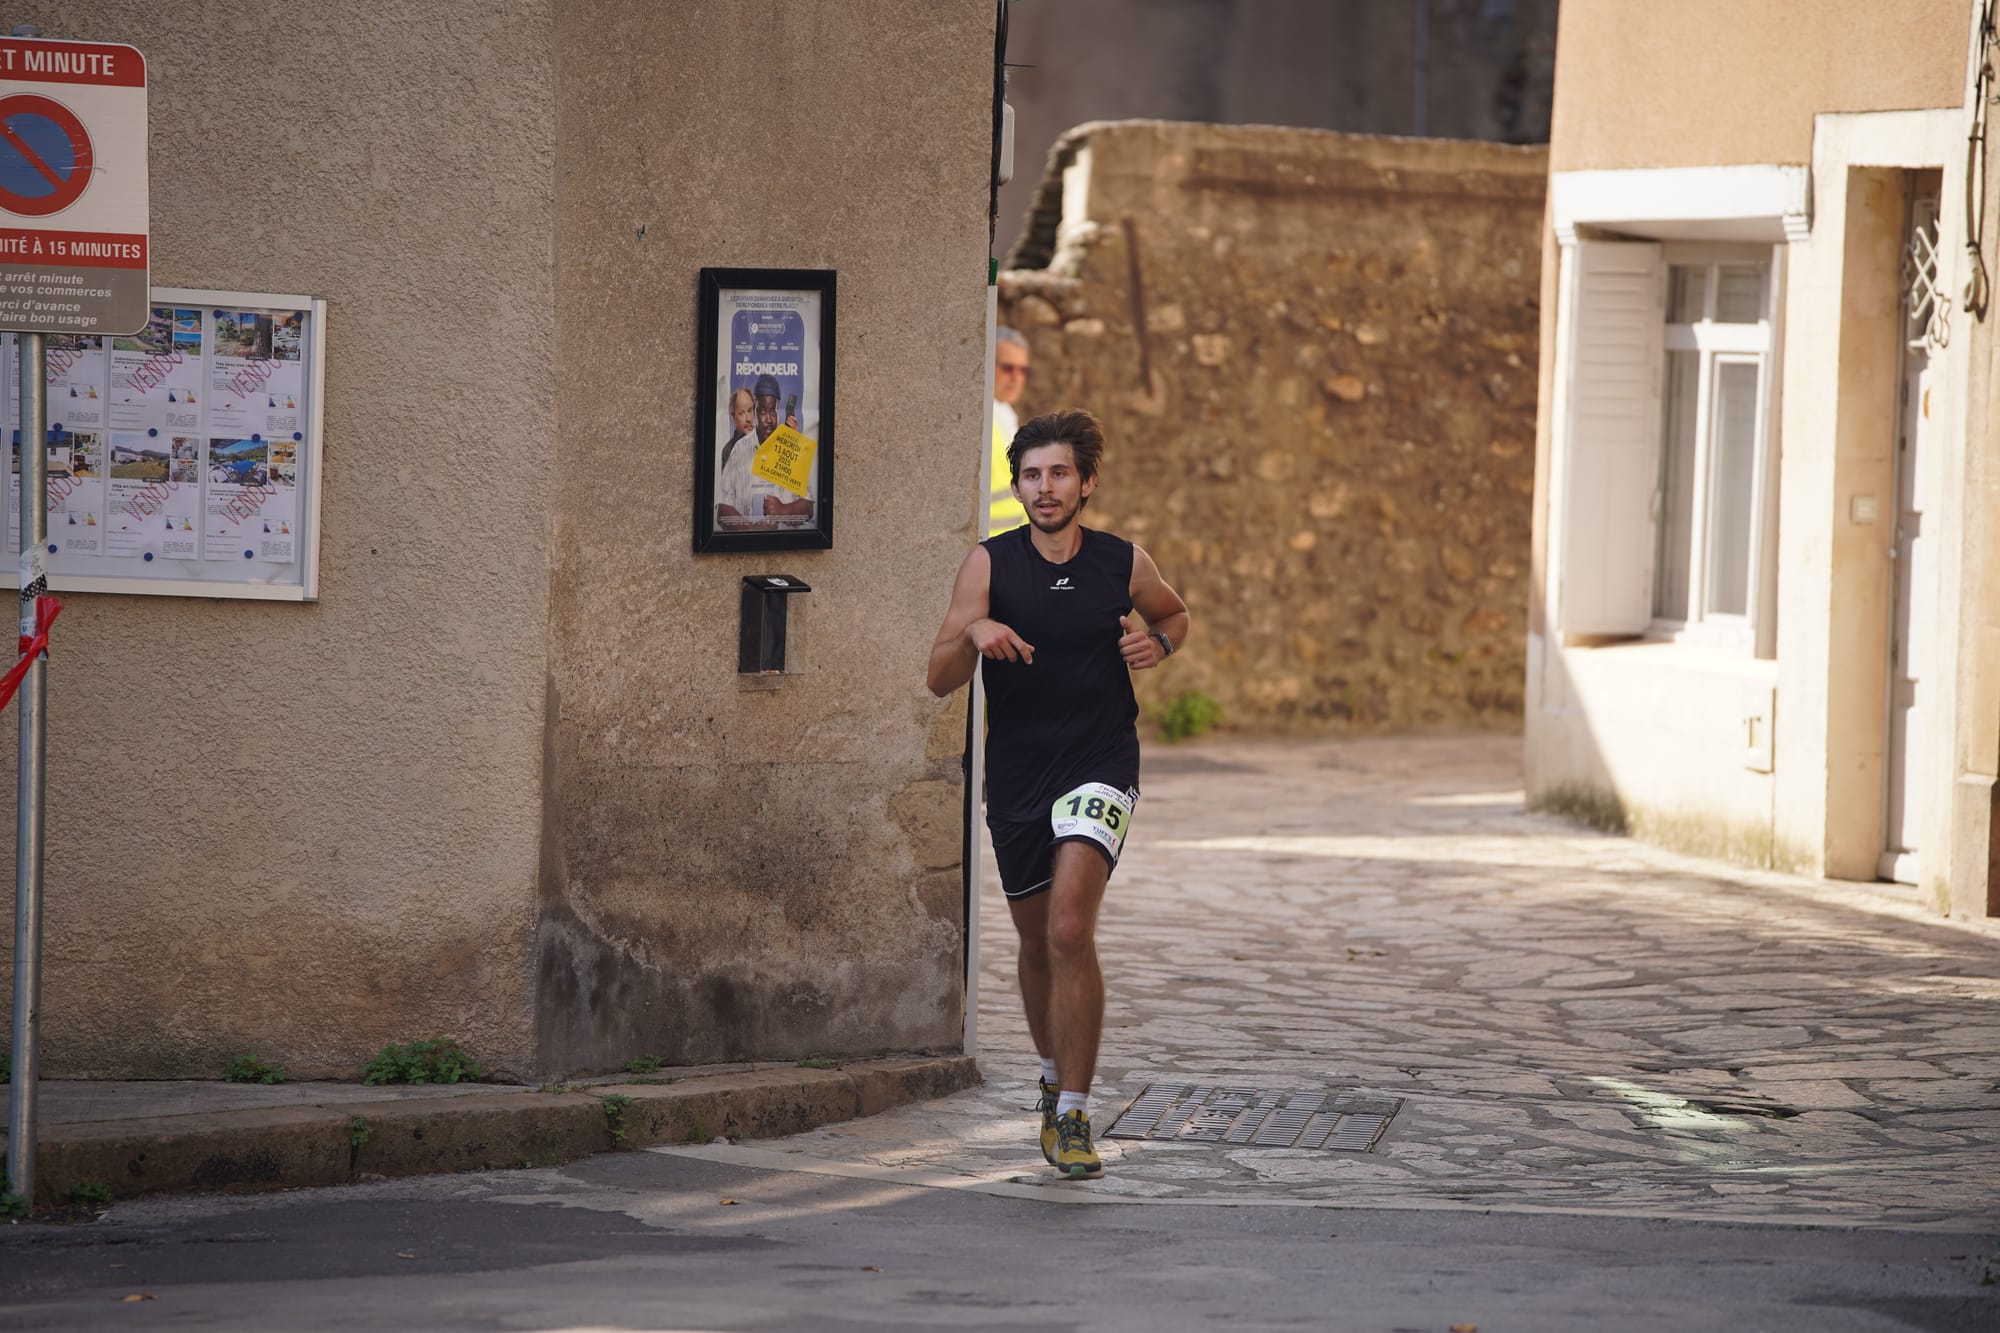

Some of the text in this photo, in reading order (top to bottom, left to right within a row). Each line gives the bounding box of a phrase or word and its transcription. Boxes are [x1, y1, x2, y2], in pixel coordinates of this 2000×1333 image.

[25, 50, 115, 76] MINUTE
[32, 236, 43, 254] À
[49, 241, 66, 256] 15
[71, 242, 141, 259] MINUTES
[5, 272, 36, 283] arrêt
[39, 274, 84, 285] minute
[10, 285, 33, 295] vos
[37, 286, 112, 298] commerces
[23, 299, 81, 312] d'avance
[30, 312, 55, 324] bon
[58, 315, 97, 328] usage
[126, 344, 183, 394] VENDU
[225, 352, 282, 399] VENDU
[122, 472, 179, 521] VENDU
[220, 478, 278, 525] VENDU
[1067, 796, 1122, 830] 185
